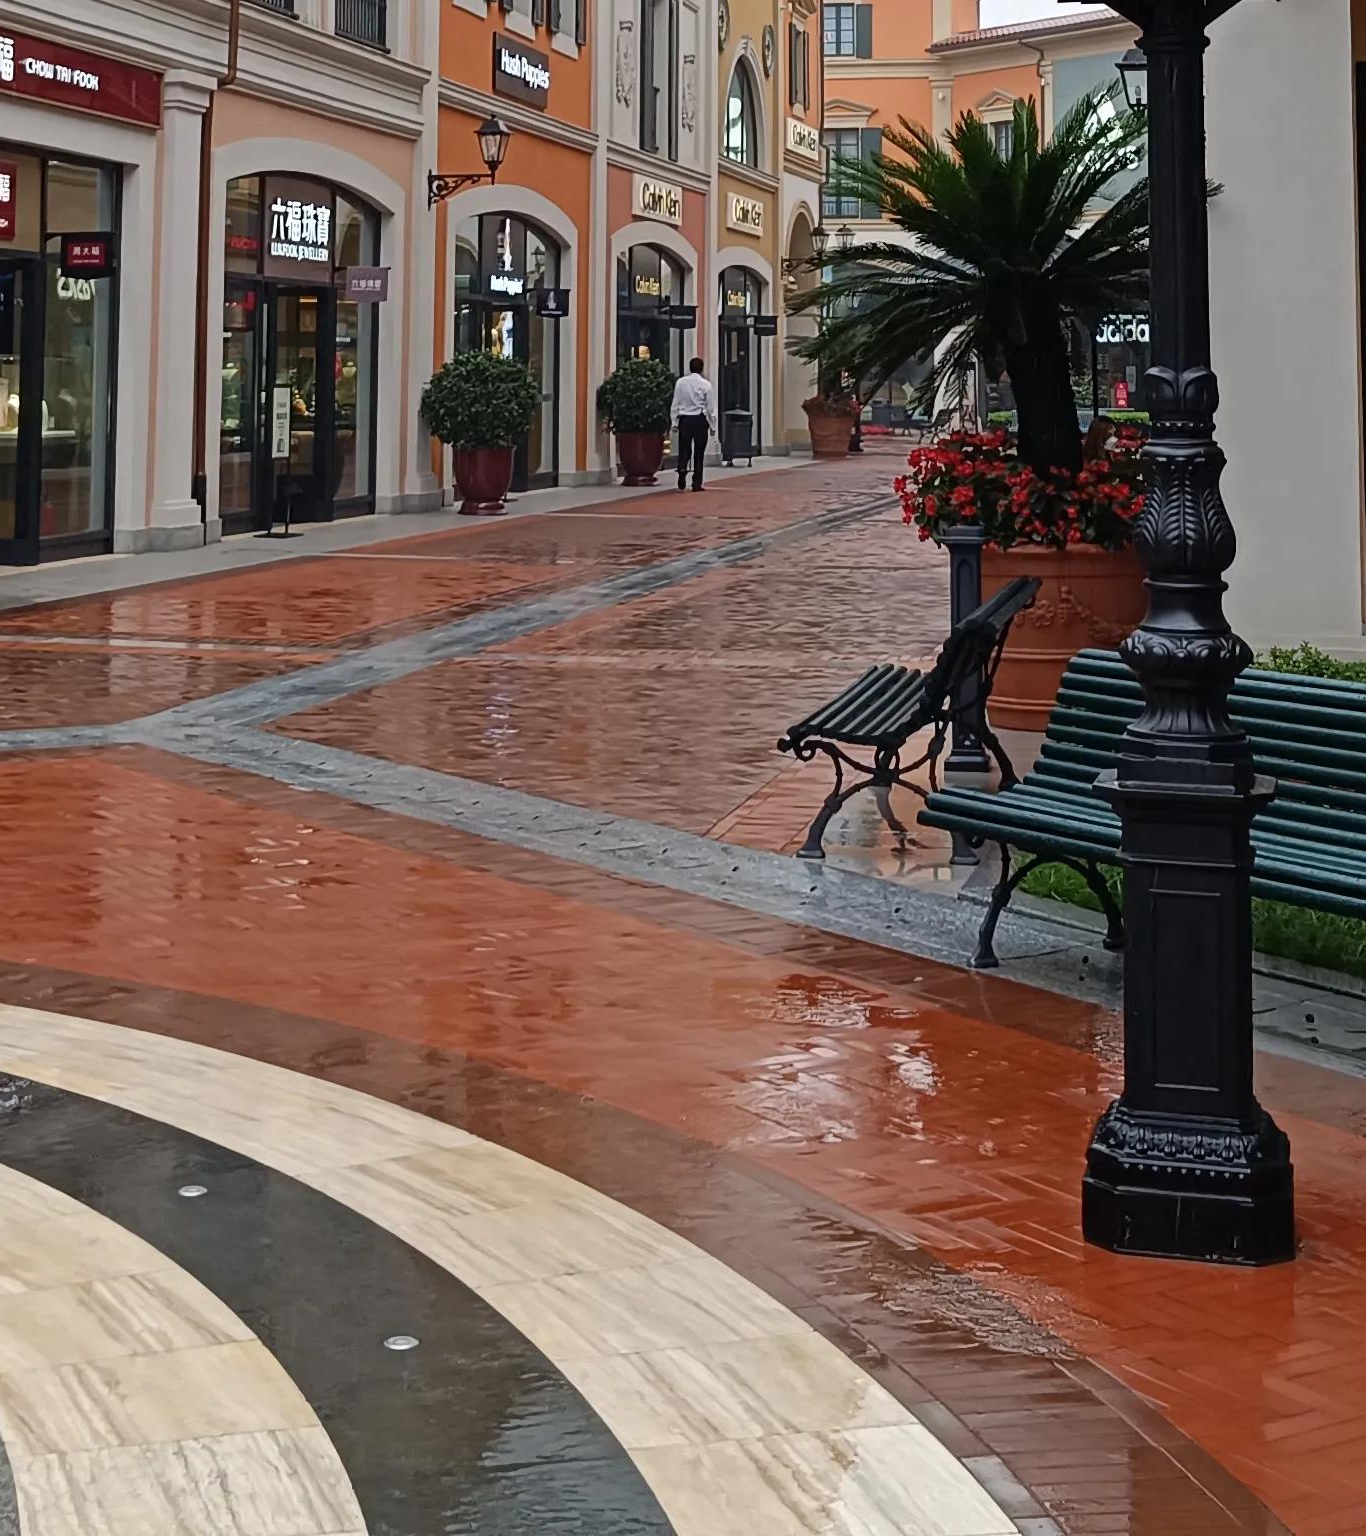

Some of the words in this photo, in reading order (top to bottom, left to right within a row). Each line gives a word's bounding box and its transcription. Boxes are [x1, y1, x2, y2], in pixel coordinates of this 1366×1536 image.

[25, 57, 54, 79] CHOW
[56, 65, 71, 83] TAI
[73, 69, 99, 91] FOOK
[501, 47, 521, 78] Hush
[521, 56, 550, 90] Puppies
[643, 182, 665, 214] Calvin
[665, 188, 680, 218] Klein
